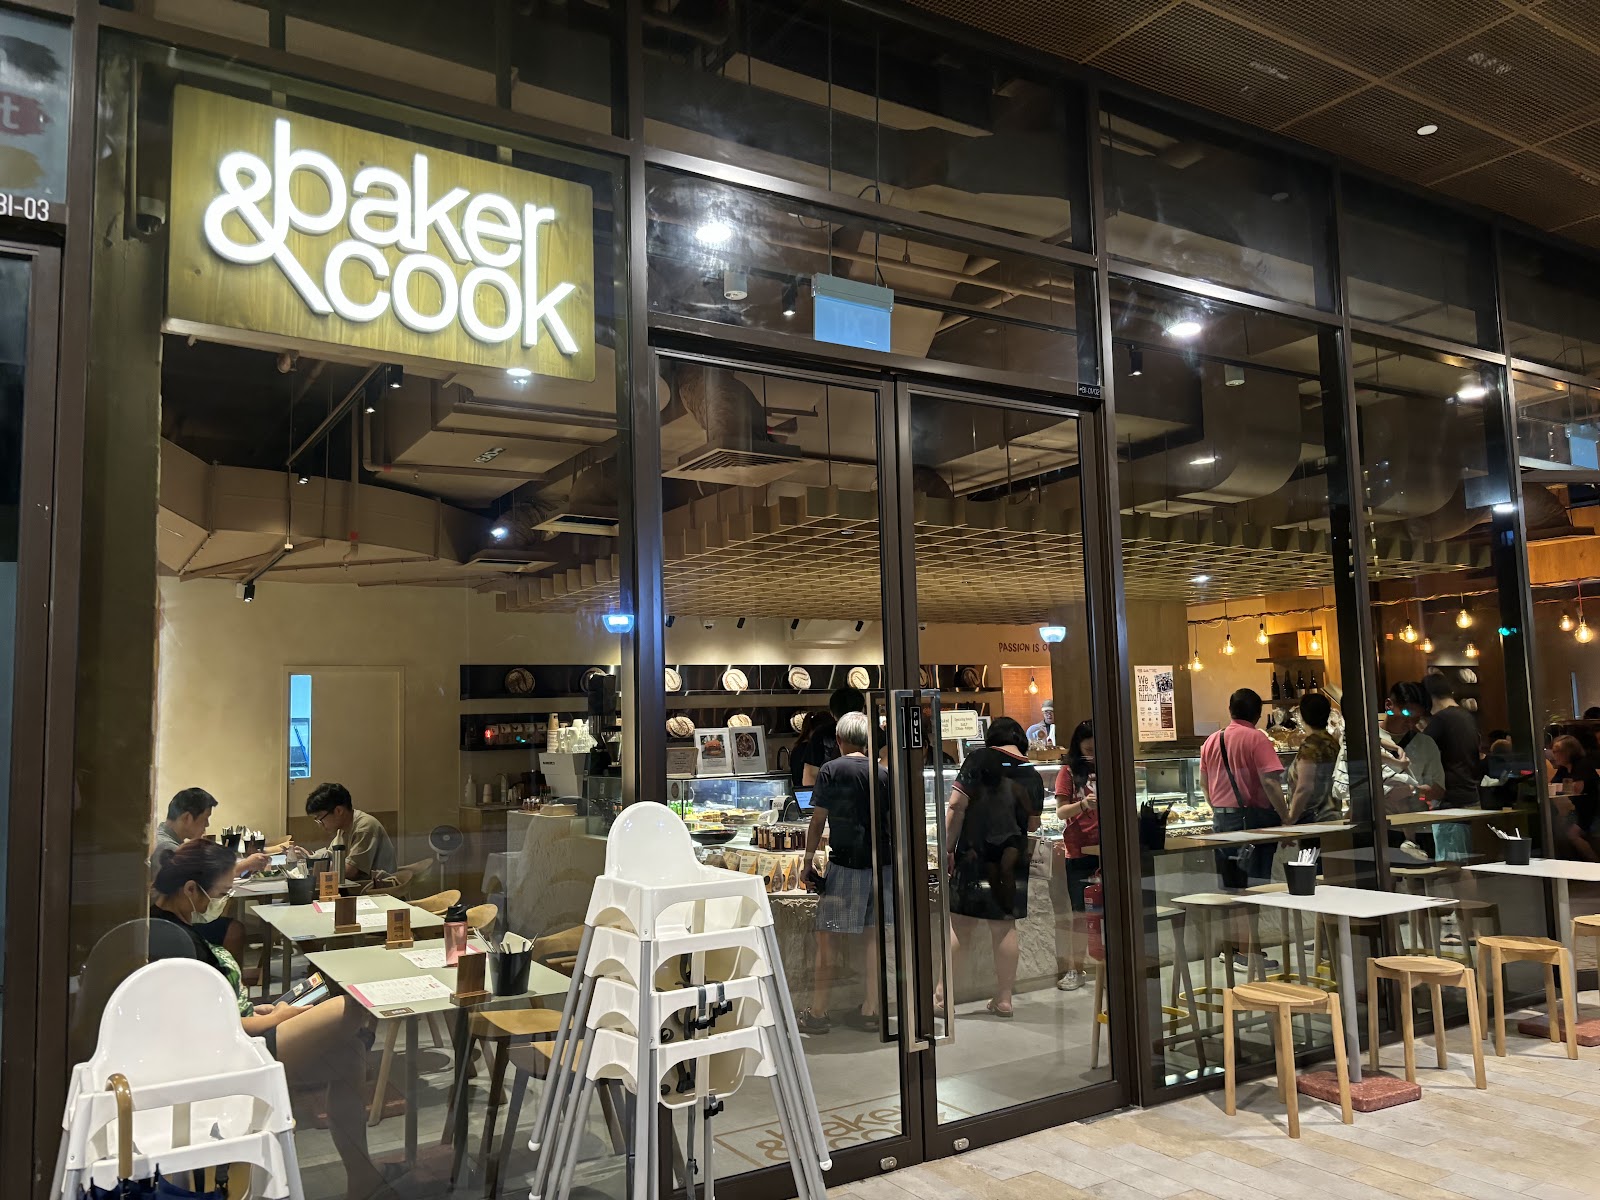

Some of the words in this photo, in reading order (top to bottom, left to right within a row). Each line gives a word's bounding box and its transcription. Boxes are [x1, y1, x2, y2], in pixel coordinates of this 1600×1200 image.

[323, 239, 579, 355] cook
[998, 642, 1030, 653] PASSION
[1032, 643, 1040, 653] IS
[1137, 675, 1149, 684] We
[1138, 684, 1149, 692] are
[912, 711, 920, 743] PULL
